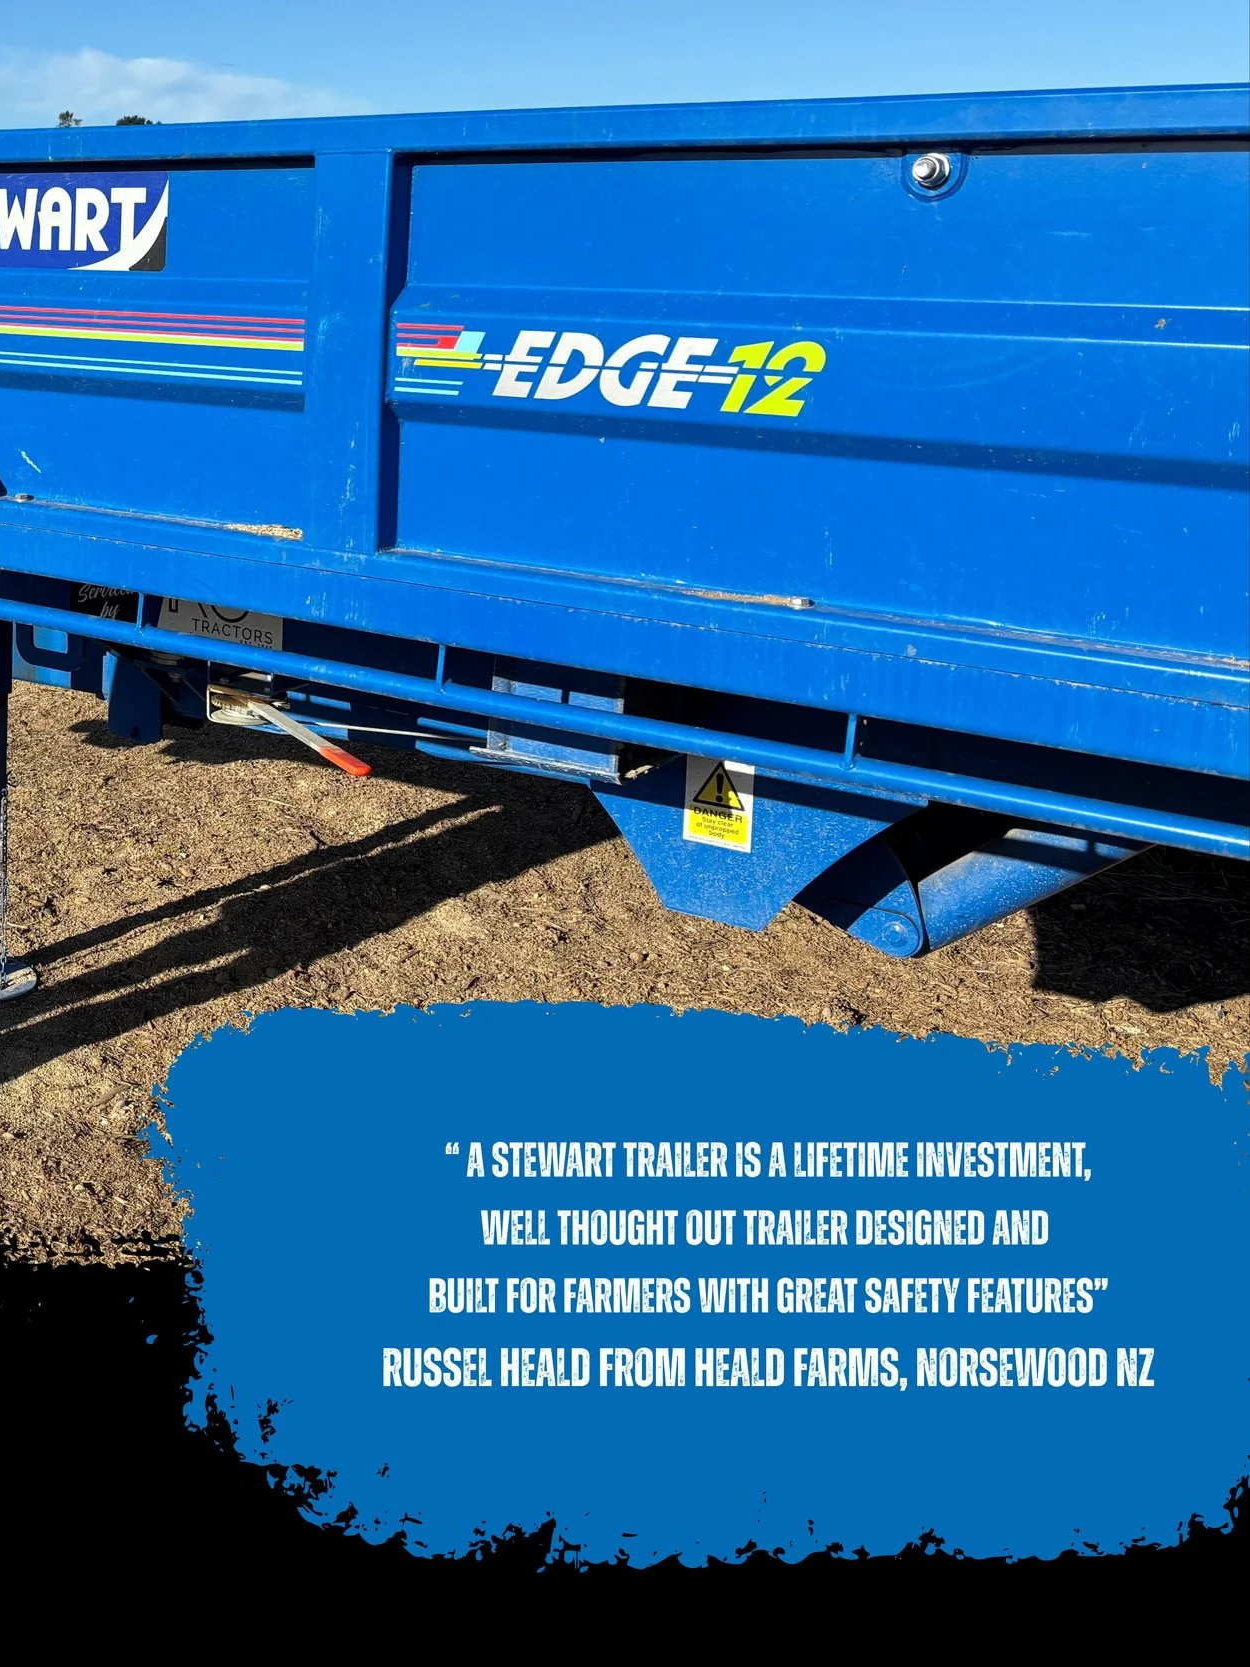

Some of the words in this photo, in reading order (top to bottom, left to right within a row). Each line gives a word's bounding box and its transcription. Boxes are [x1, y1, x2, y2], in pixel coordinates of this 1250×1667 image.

[492, 331, 719, 409] EDGE
[77, 583, 134, 603] Servic
[100, 601, 121, 620] by
[192, 618, 273, 645] TRACTORS
[693, 806, 743, 823] DANGER
[702, 816, 717, 825] Stay
[717, 820, 734, 828] clear
[704, 824, 739, 835] unpropped
[709, 830, 726, 839] body
